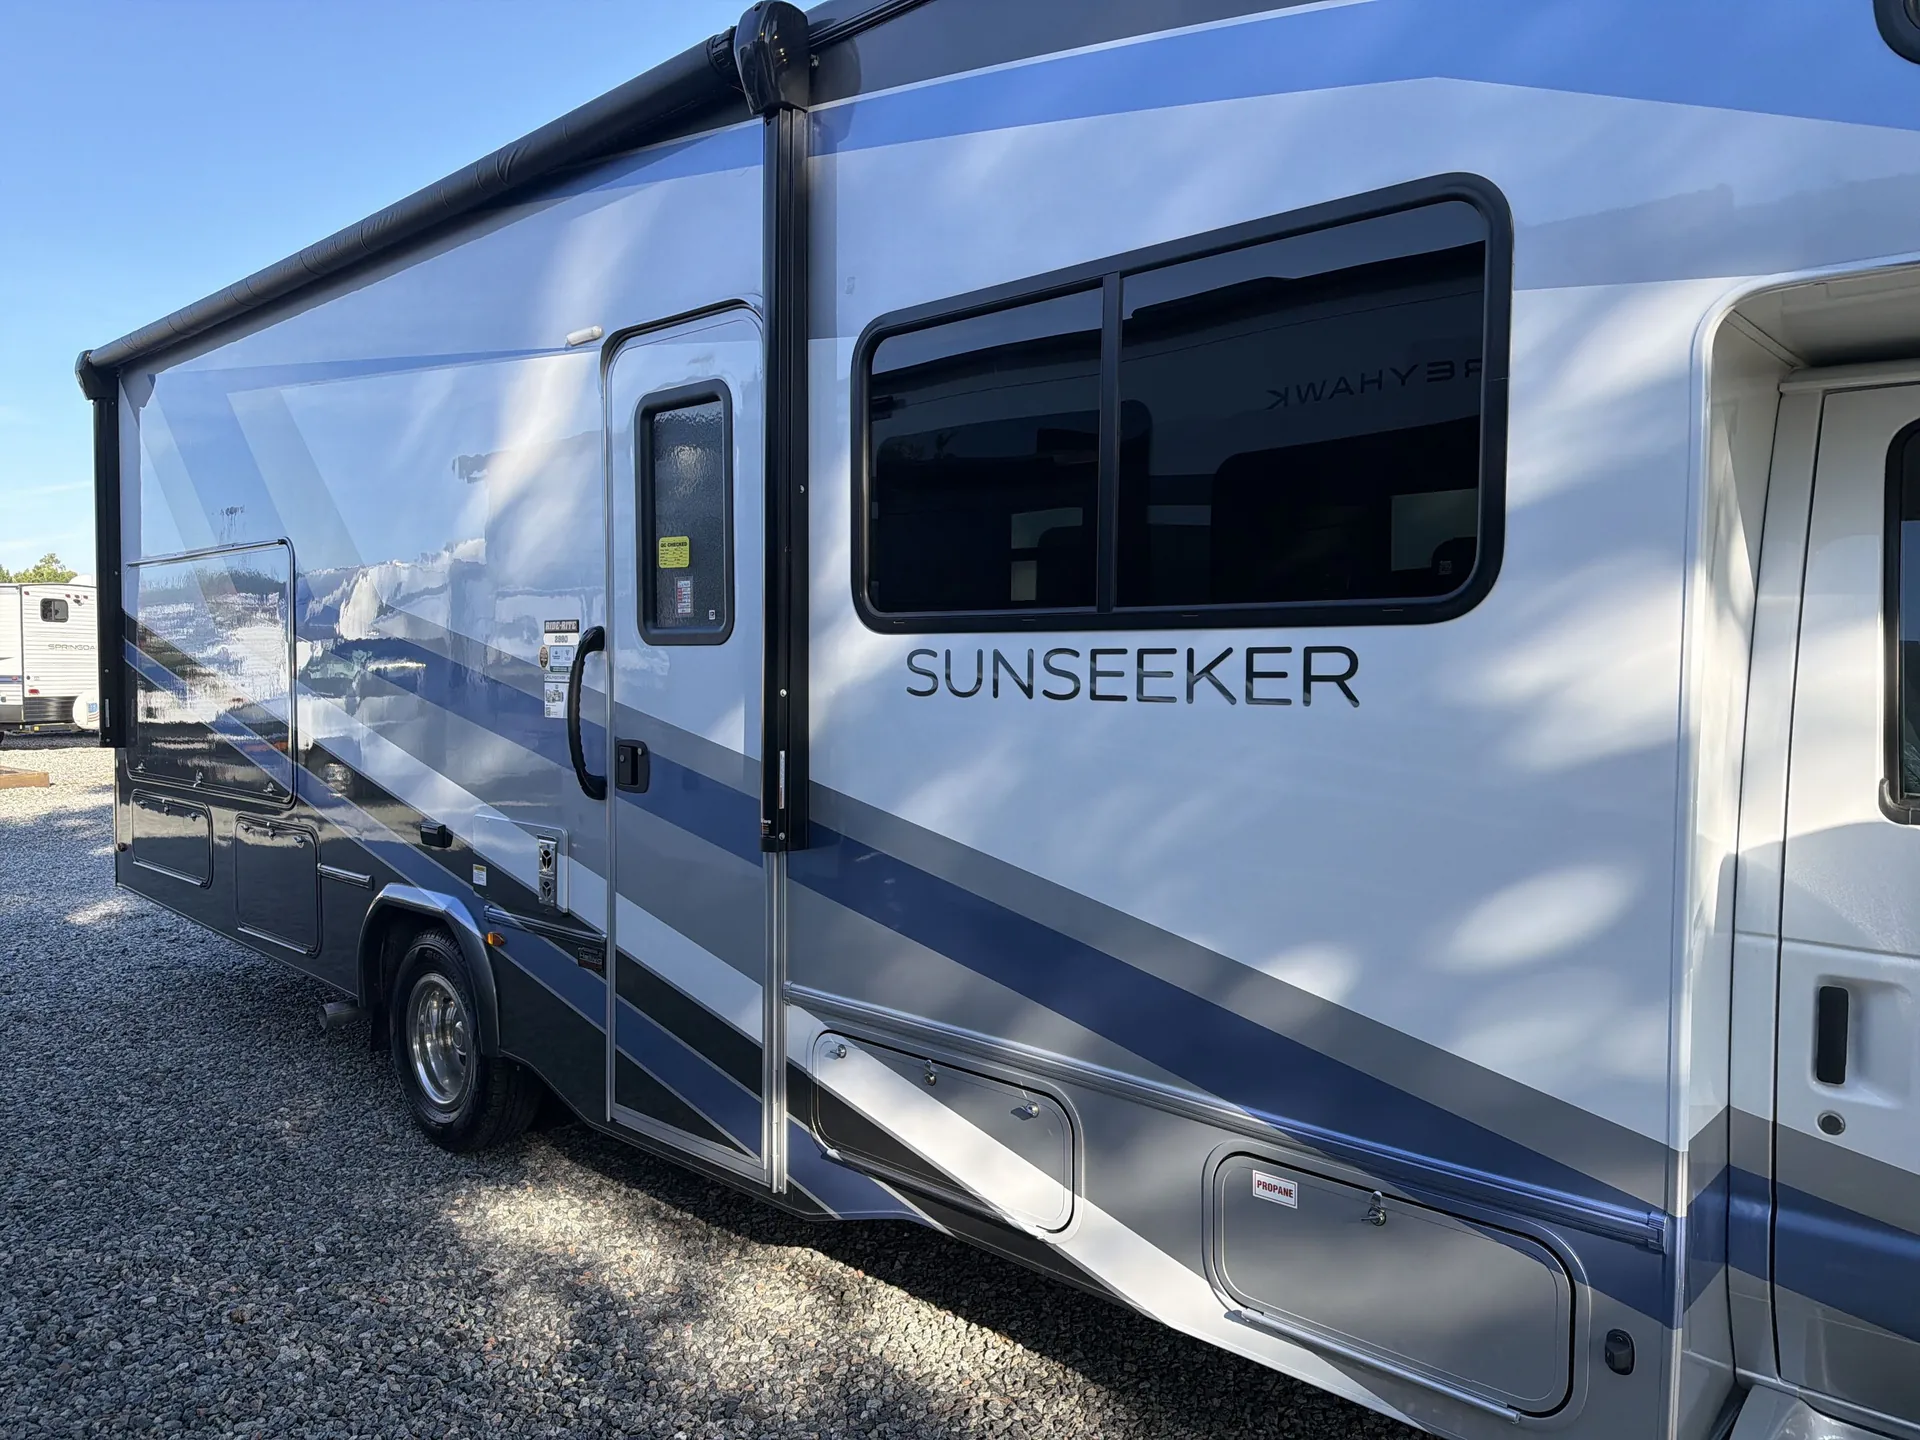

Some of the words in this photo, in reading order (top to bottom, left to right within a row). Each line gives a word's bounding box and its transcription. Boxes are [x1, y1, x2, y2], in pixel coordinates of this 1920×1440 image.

[545, 621, 578, 630] RIDE-RITE
[906, 646, 1360, 708] SUNSEEKER
[1256, 1180, 1294, 1198] PROPANE
